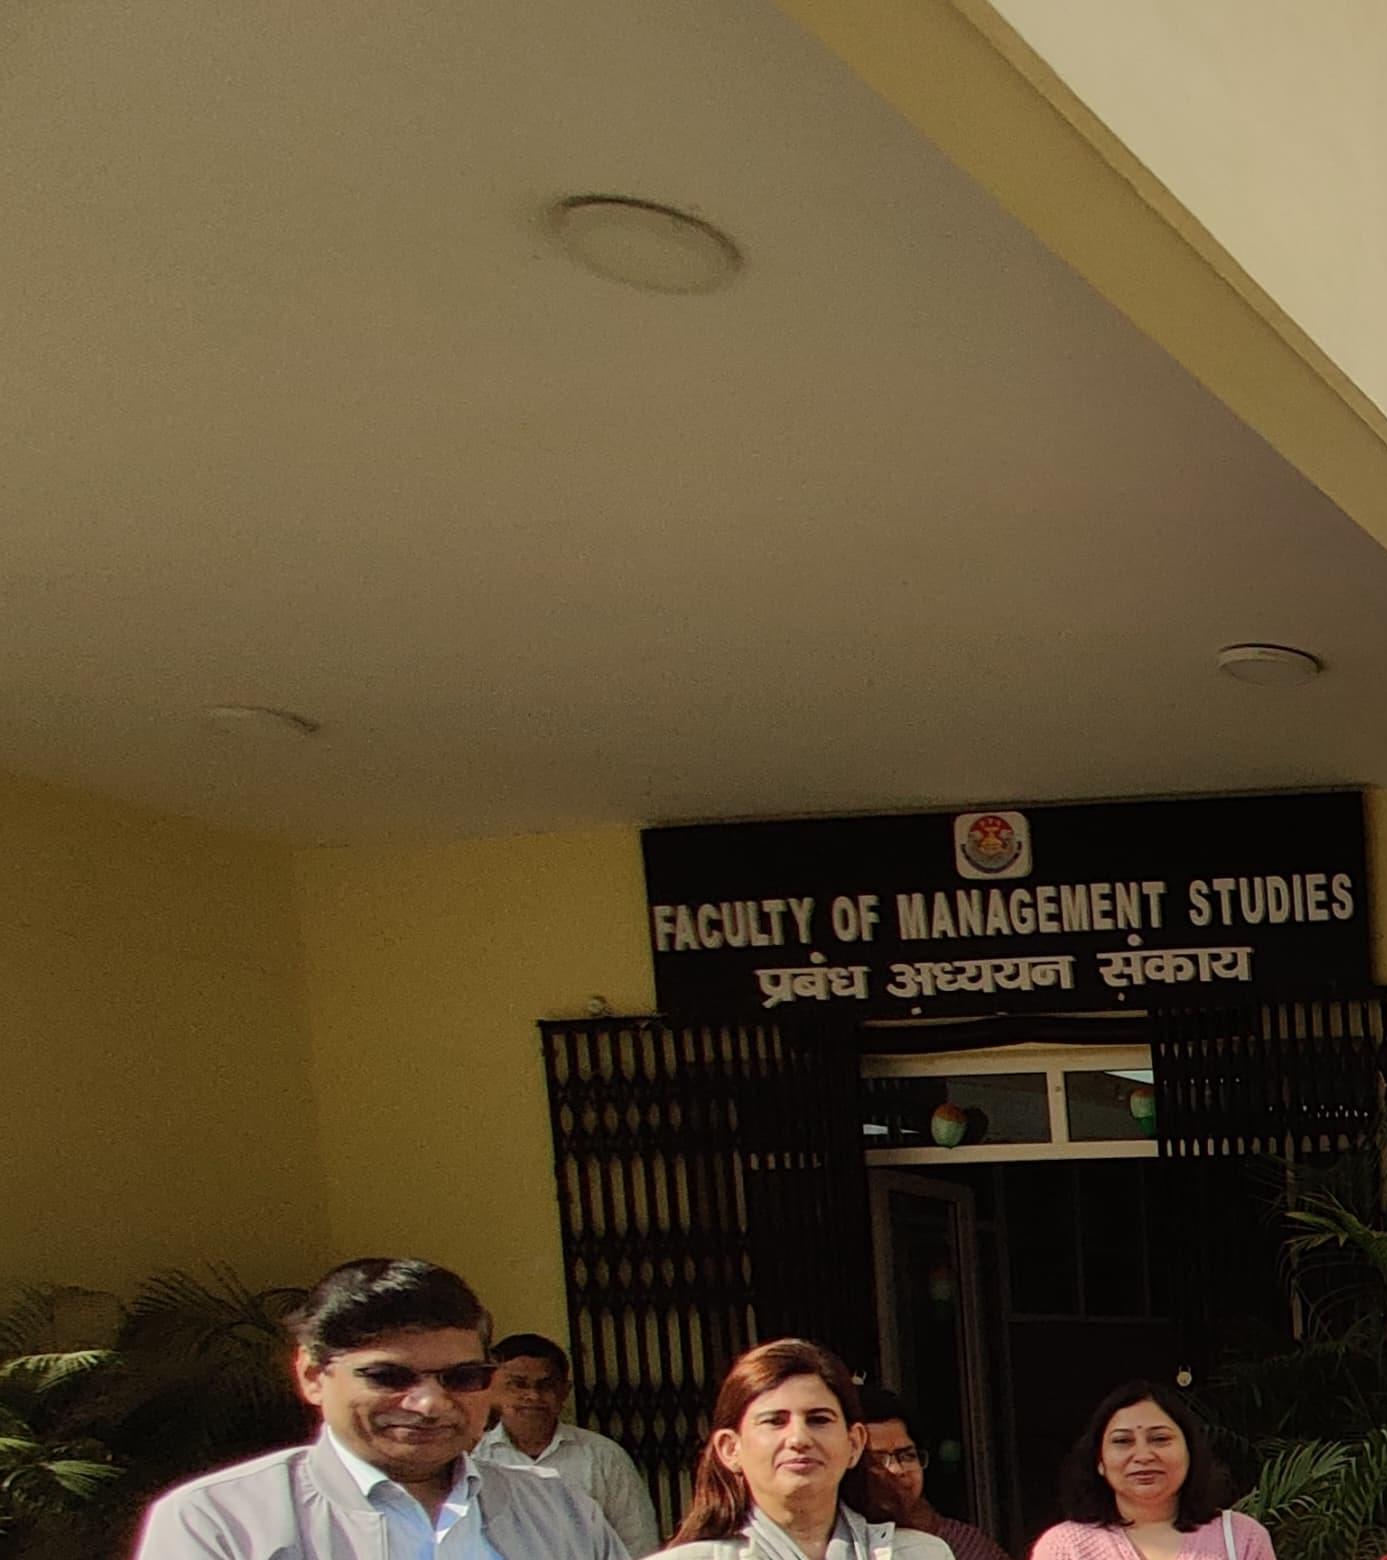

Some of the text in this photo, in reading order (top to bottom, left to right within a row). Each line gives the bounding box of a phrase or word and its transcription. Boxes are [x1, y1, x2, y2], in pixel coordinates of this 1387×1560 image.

[653, 873, 1354, 952] FACULTY OF MANAGEMENT STUDIES
[754, 933, 1254, 1009] प्रबंध अध्ययन संकाय
